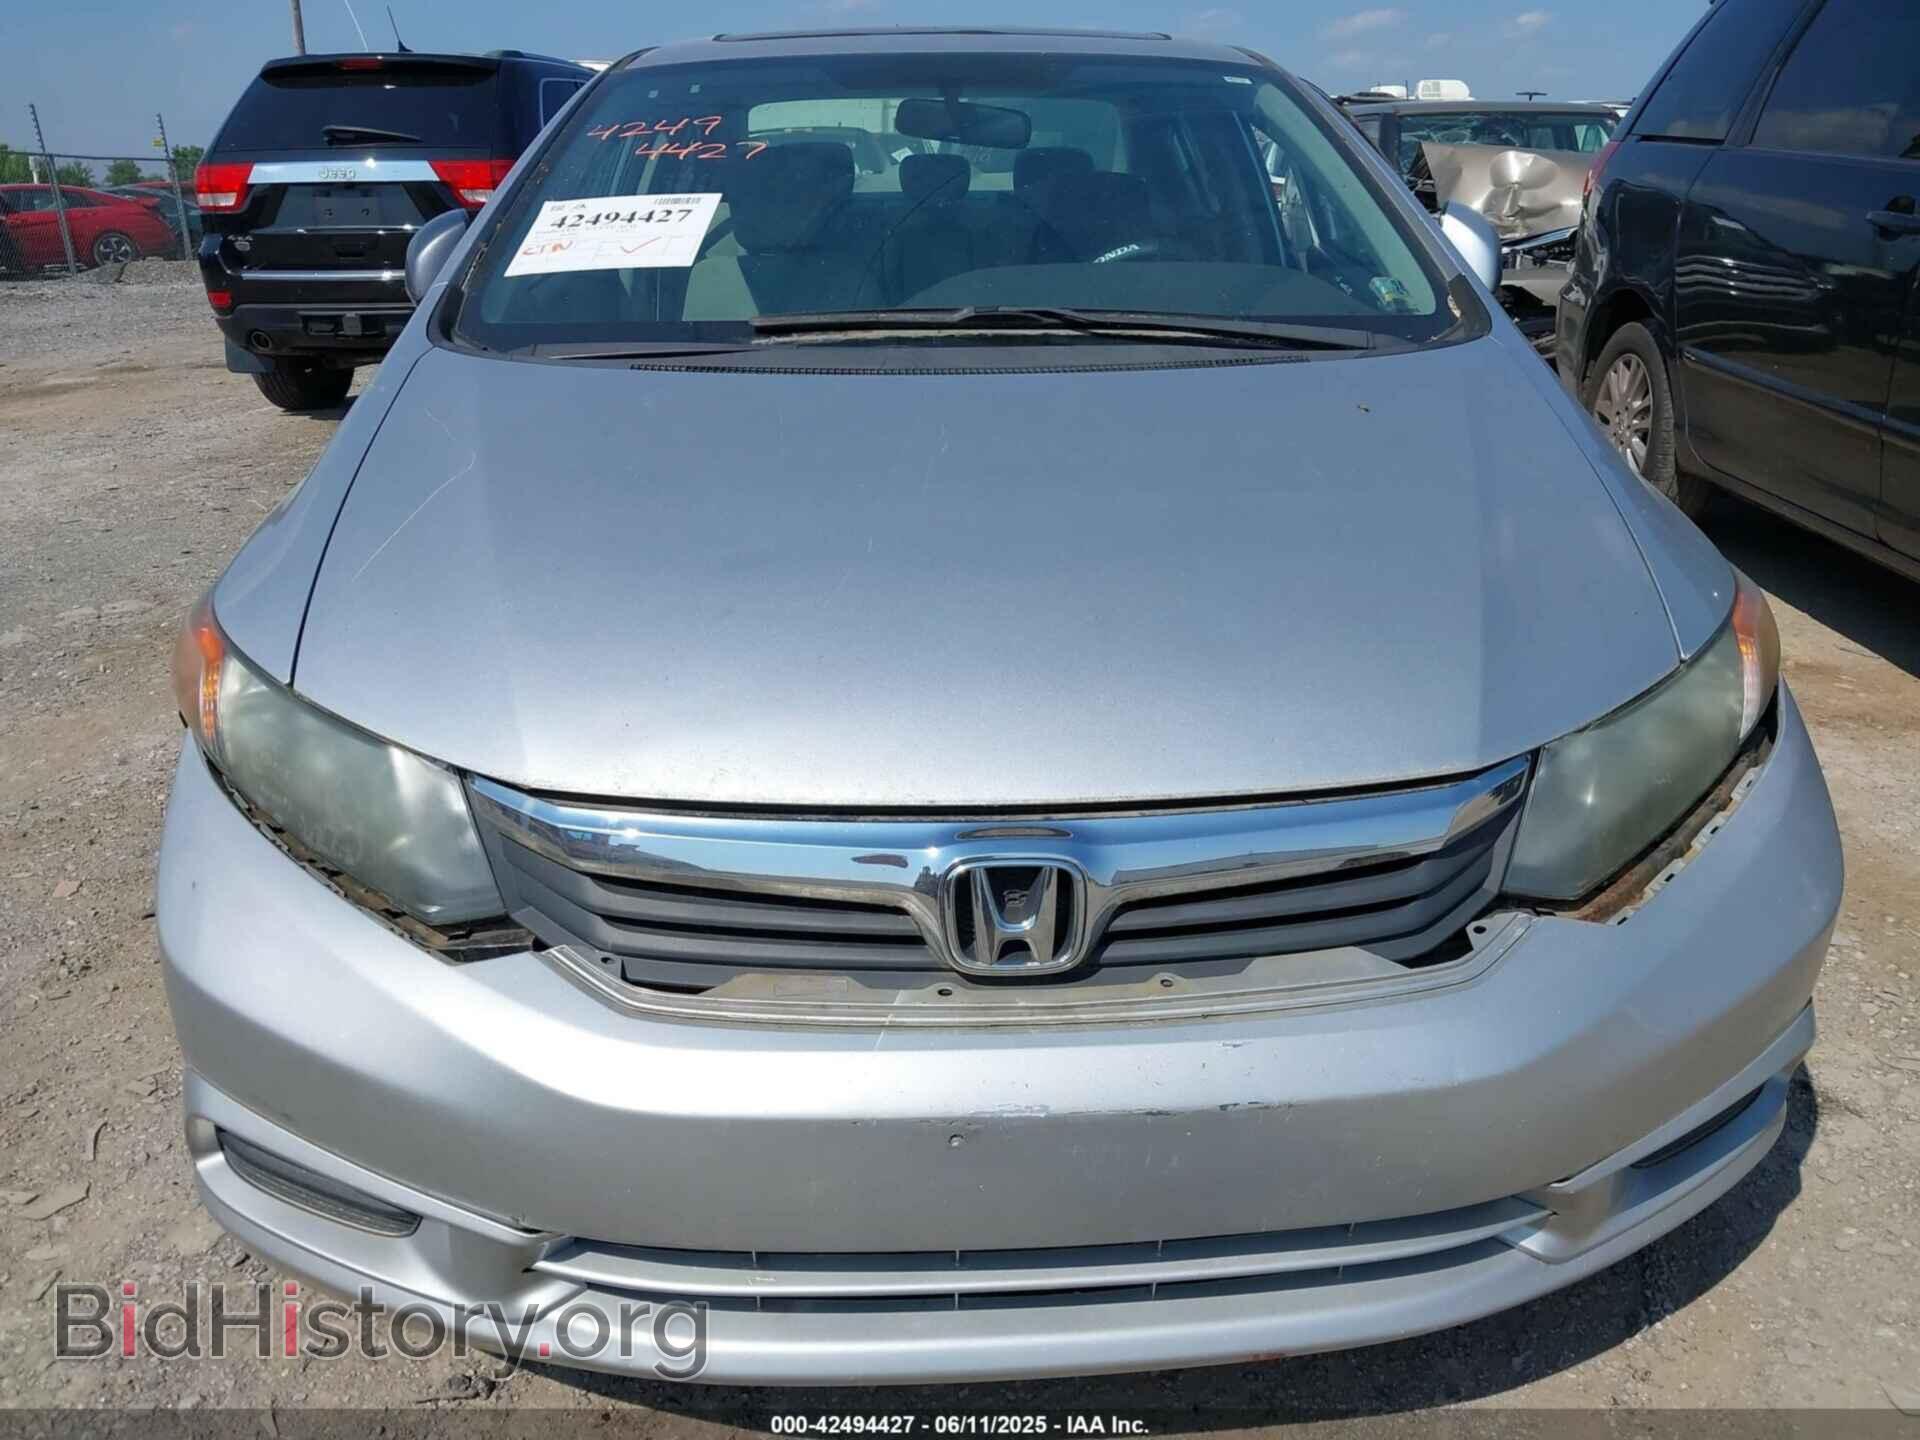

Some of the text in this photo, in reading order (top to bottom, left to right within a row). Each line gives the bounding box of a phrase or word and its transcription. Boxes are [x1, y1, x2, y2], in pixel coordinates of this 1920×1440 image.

[587, 115, 722, 140] 4249
[635, 141, 768, 160] 4427
[319, 167, 357, 181] Jeep
[550, 209, 693, 228] 42494427
